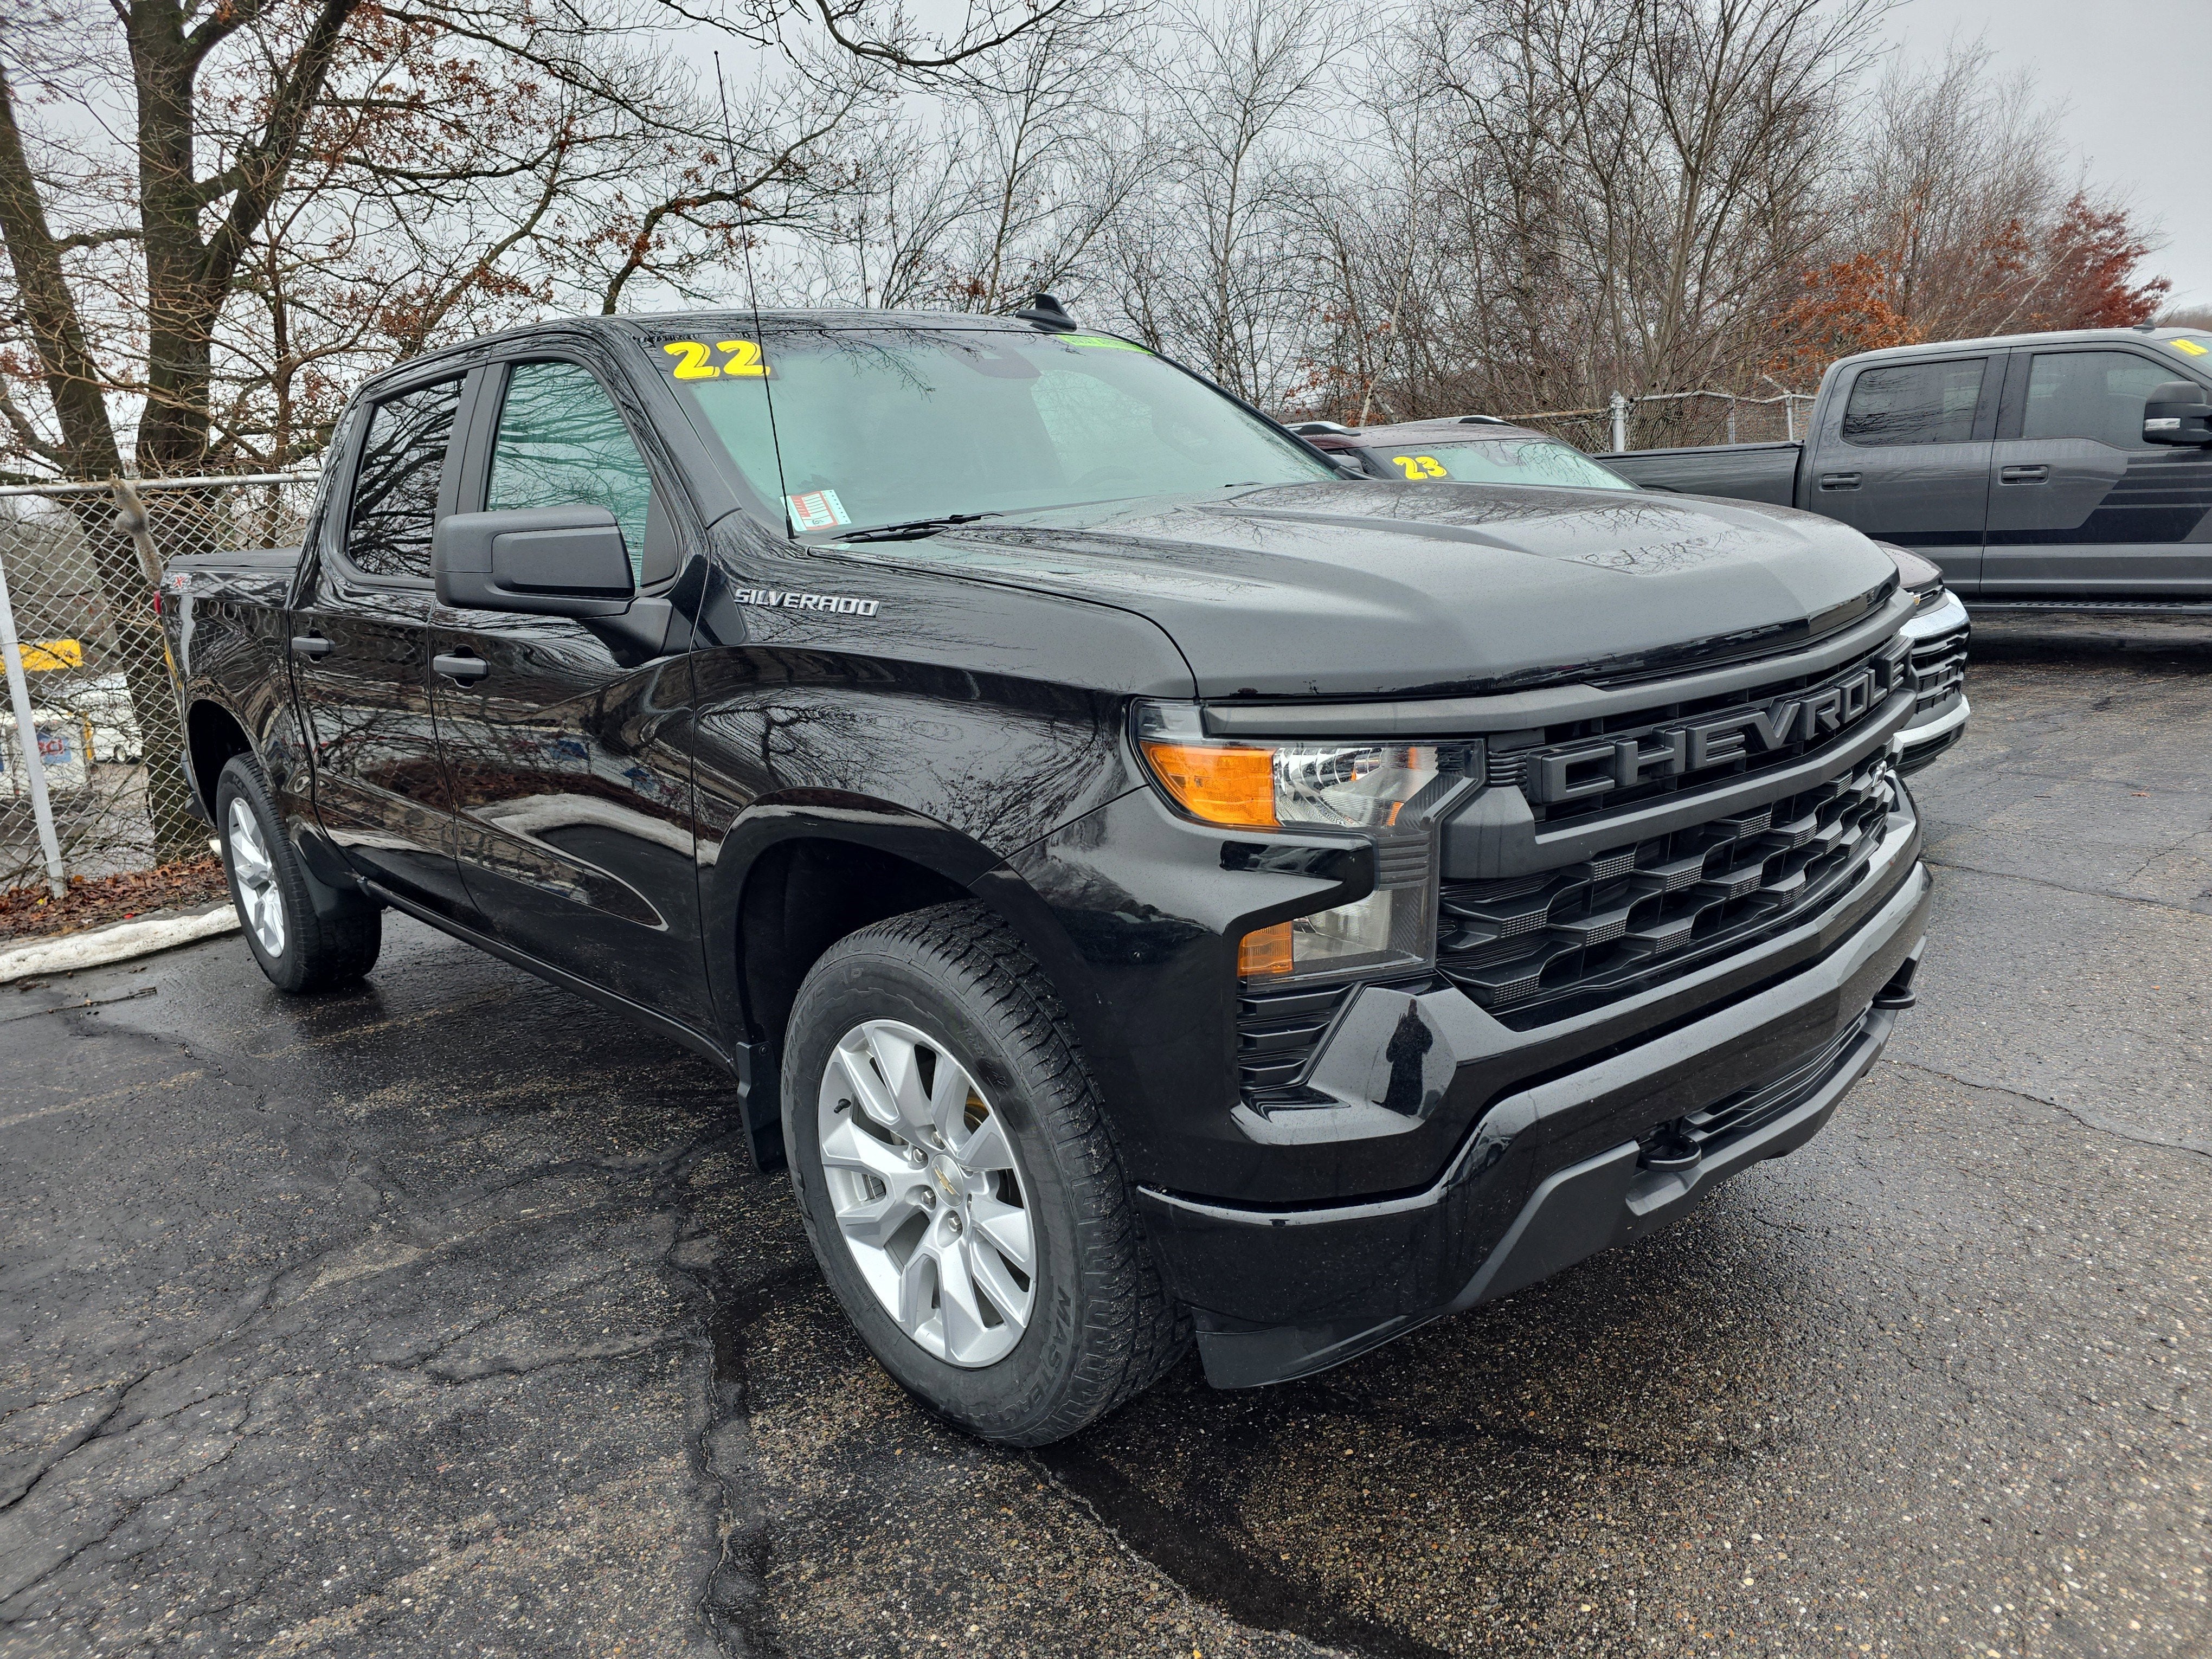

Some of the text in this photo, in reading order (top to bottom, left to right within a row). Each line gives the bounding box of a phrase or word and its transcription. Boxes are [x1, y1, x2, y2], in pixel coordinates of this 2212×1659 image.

[664, 340, 770, 380] 22
[1393, 456, 1447, 479] 23
[734, 589, 879, 617] SILVERADO
